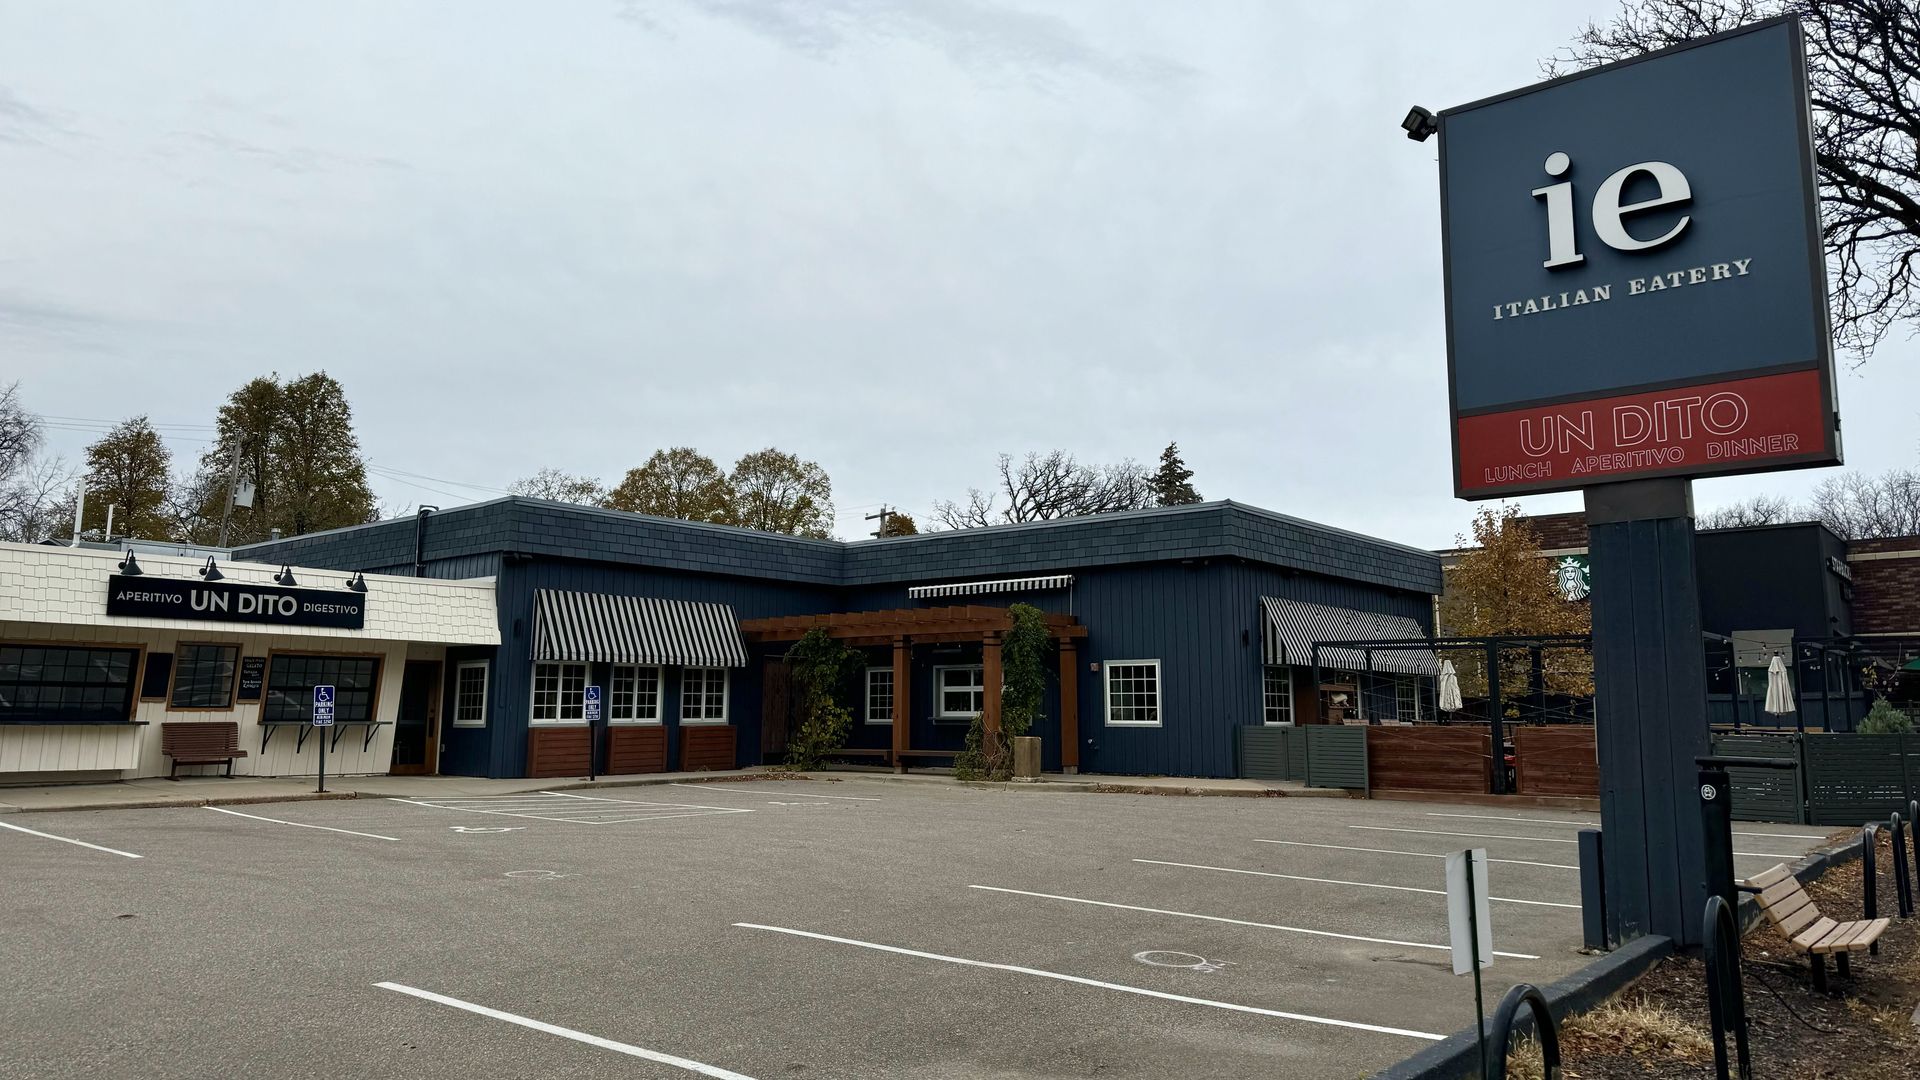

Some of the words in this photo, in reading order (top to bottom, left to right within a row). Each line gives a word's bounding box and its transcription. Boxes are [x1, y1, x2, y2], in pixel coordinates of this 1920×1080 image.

[1531, 151, 1692, 268] ie
[1493, 284, 1612, 320] ITALIAN
[1628, 258, 1752, 296] EATERY
[1520, 410, 1595, 457] UN
[1613, 391, 1749, 447] DITO
[1484, 461, 1552, 483] LUNCH
[1571, 446, 1685, 474] APERITIVO
[1705, 433, 1799, 459] DINNER
[116, 590, 183, 604] APERITIVO
[190, 589, 229, 613] UN
[238, 593, 298, 616] DITO
[303, 602, 359, 615] DIGESTIVO
